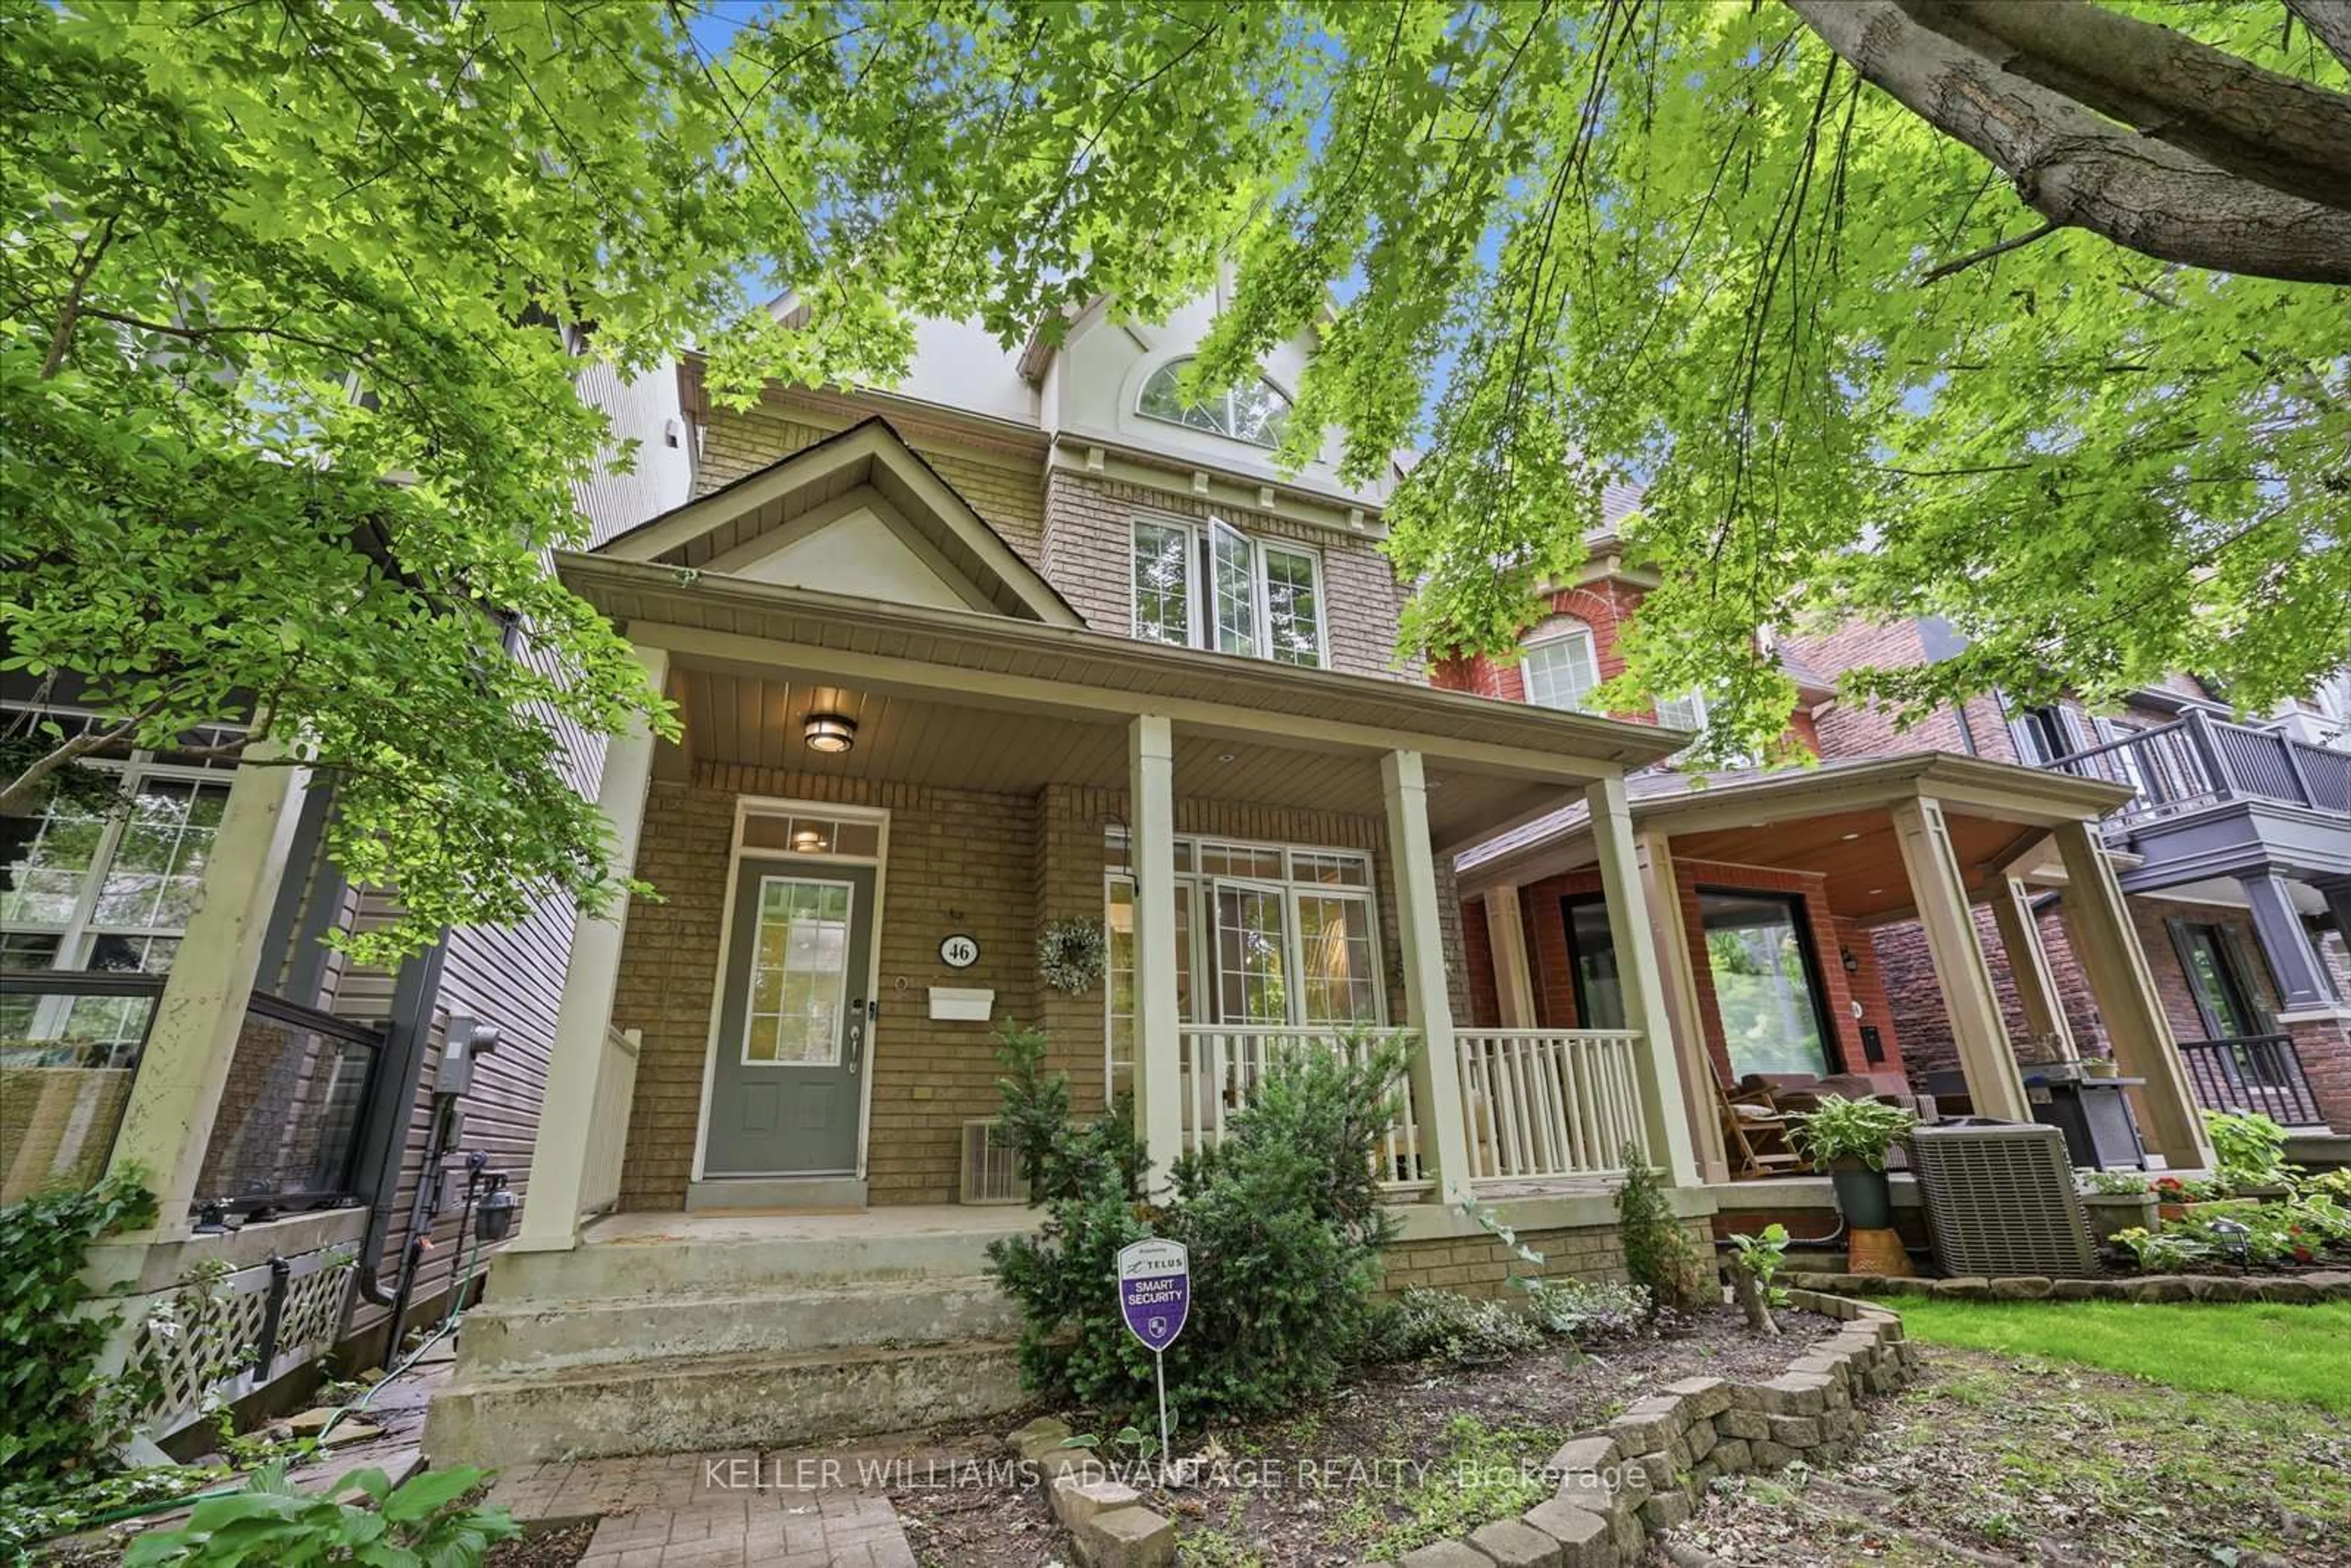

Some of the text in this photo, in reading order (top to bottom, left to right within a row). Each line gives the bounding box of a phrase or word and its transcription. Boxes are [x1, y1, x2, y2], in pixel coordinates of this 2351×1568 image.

[949, 943, 969, 960] 46
[1147, 1258, 1182, 1269] TELUS
[1136, 1279, 1174, 1292] SMART
[1128, 1289, 1182, 1305] SECURITY
